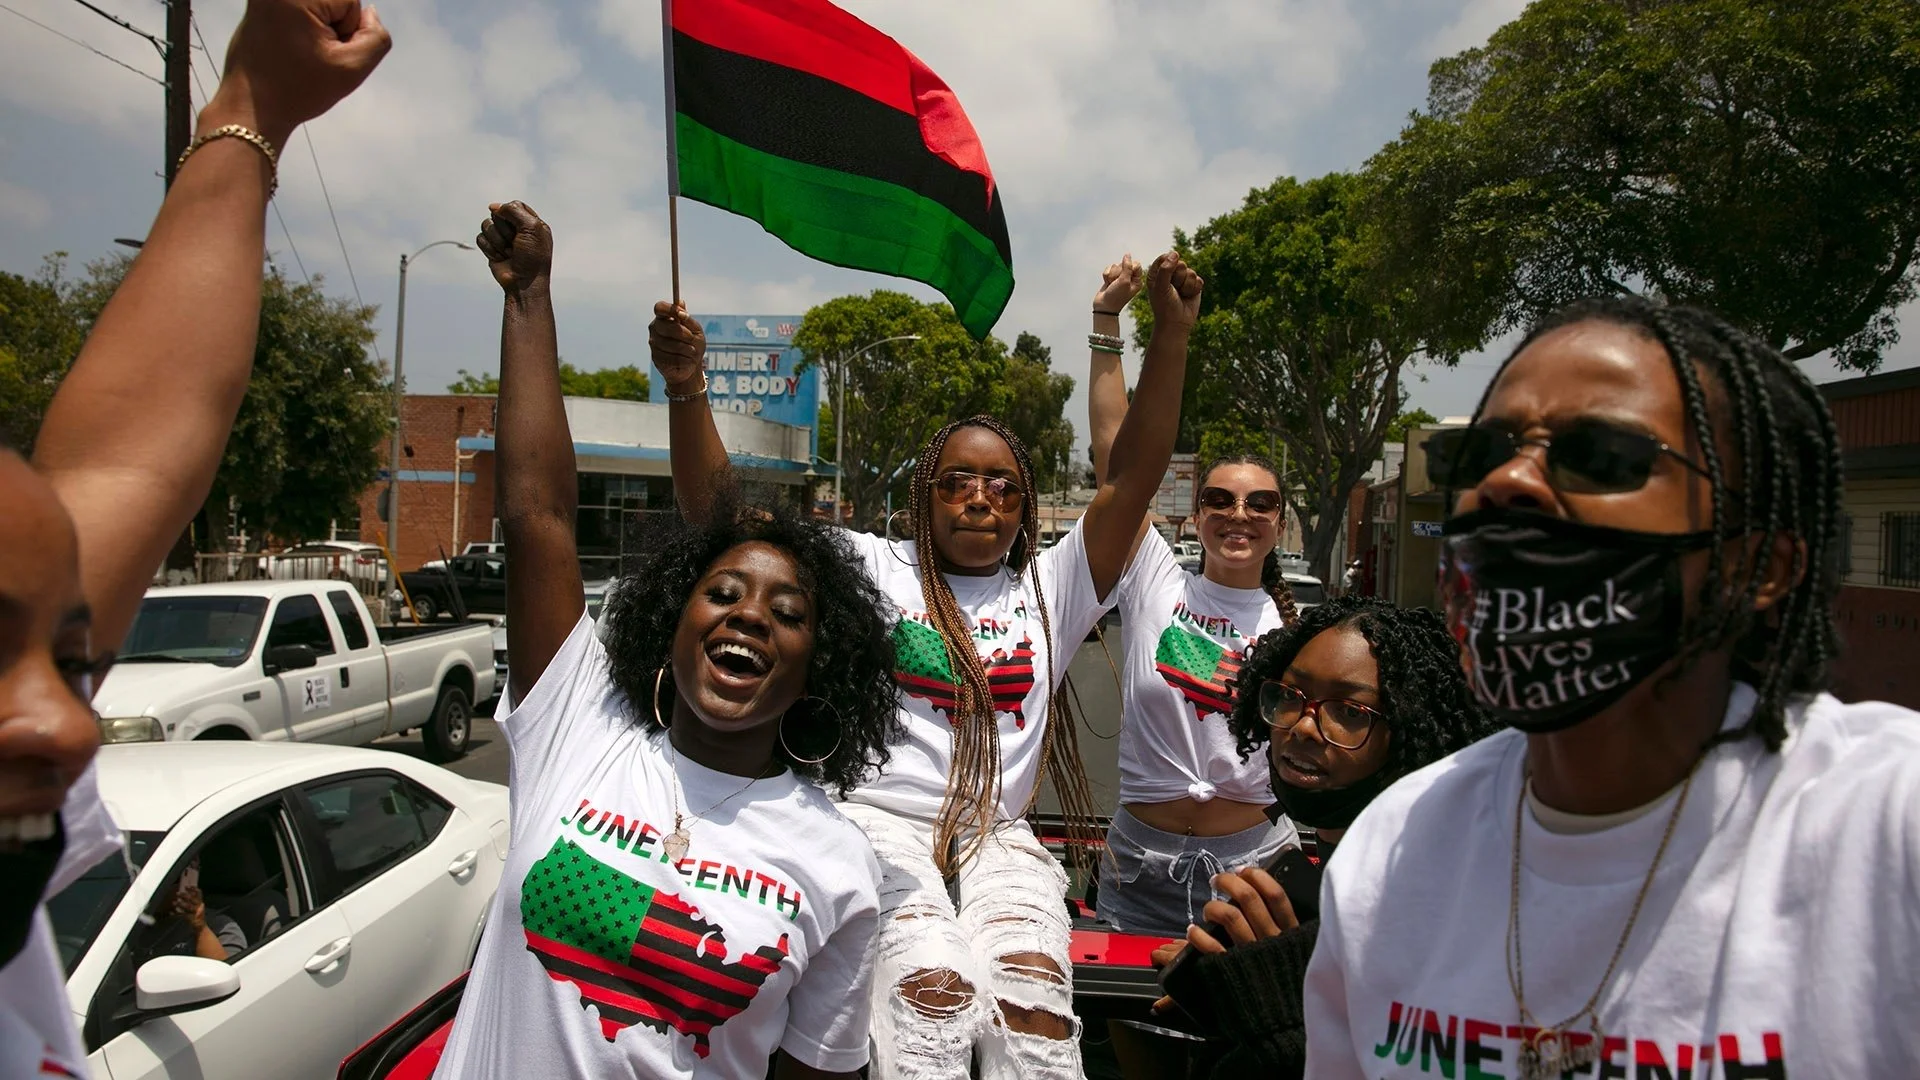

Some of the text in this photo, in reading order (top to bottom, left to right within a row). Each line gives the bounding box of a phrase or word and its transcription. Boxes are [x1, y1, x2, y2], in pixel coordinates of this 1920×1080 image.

[709, 398, 763, 416] HOP
[711, 375, 800, 396] & BODY
[1472, 579, 1639, 635] #Black
[1469, 628, 1593, 673] Lives
[1474, 656, 1638, 711] Matter
[560, 798, 802, 921] JUNEEENTH
